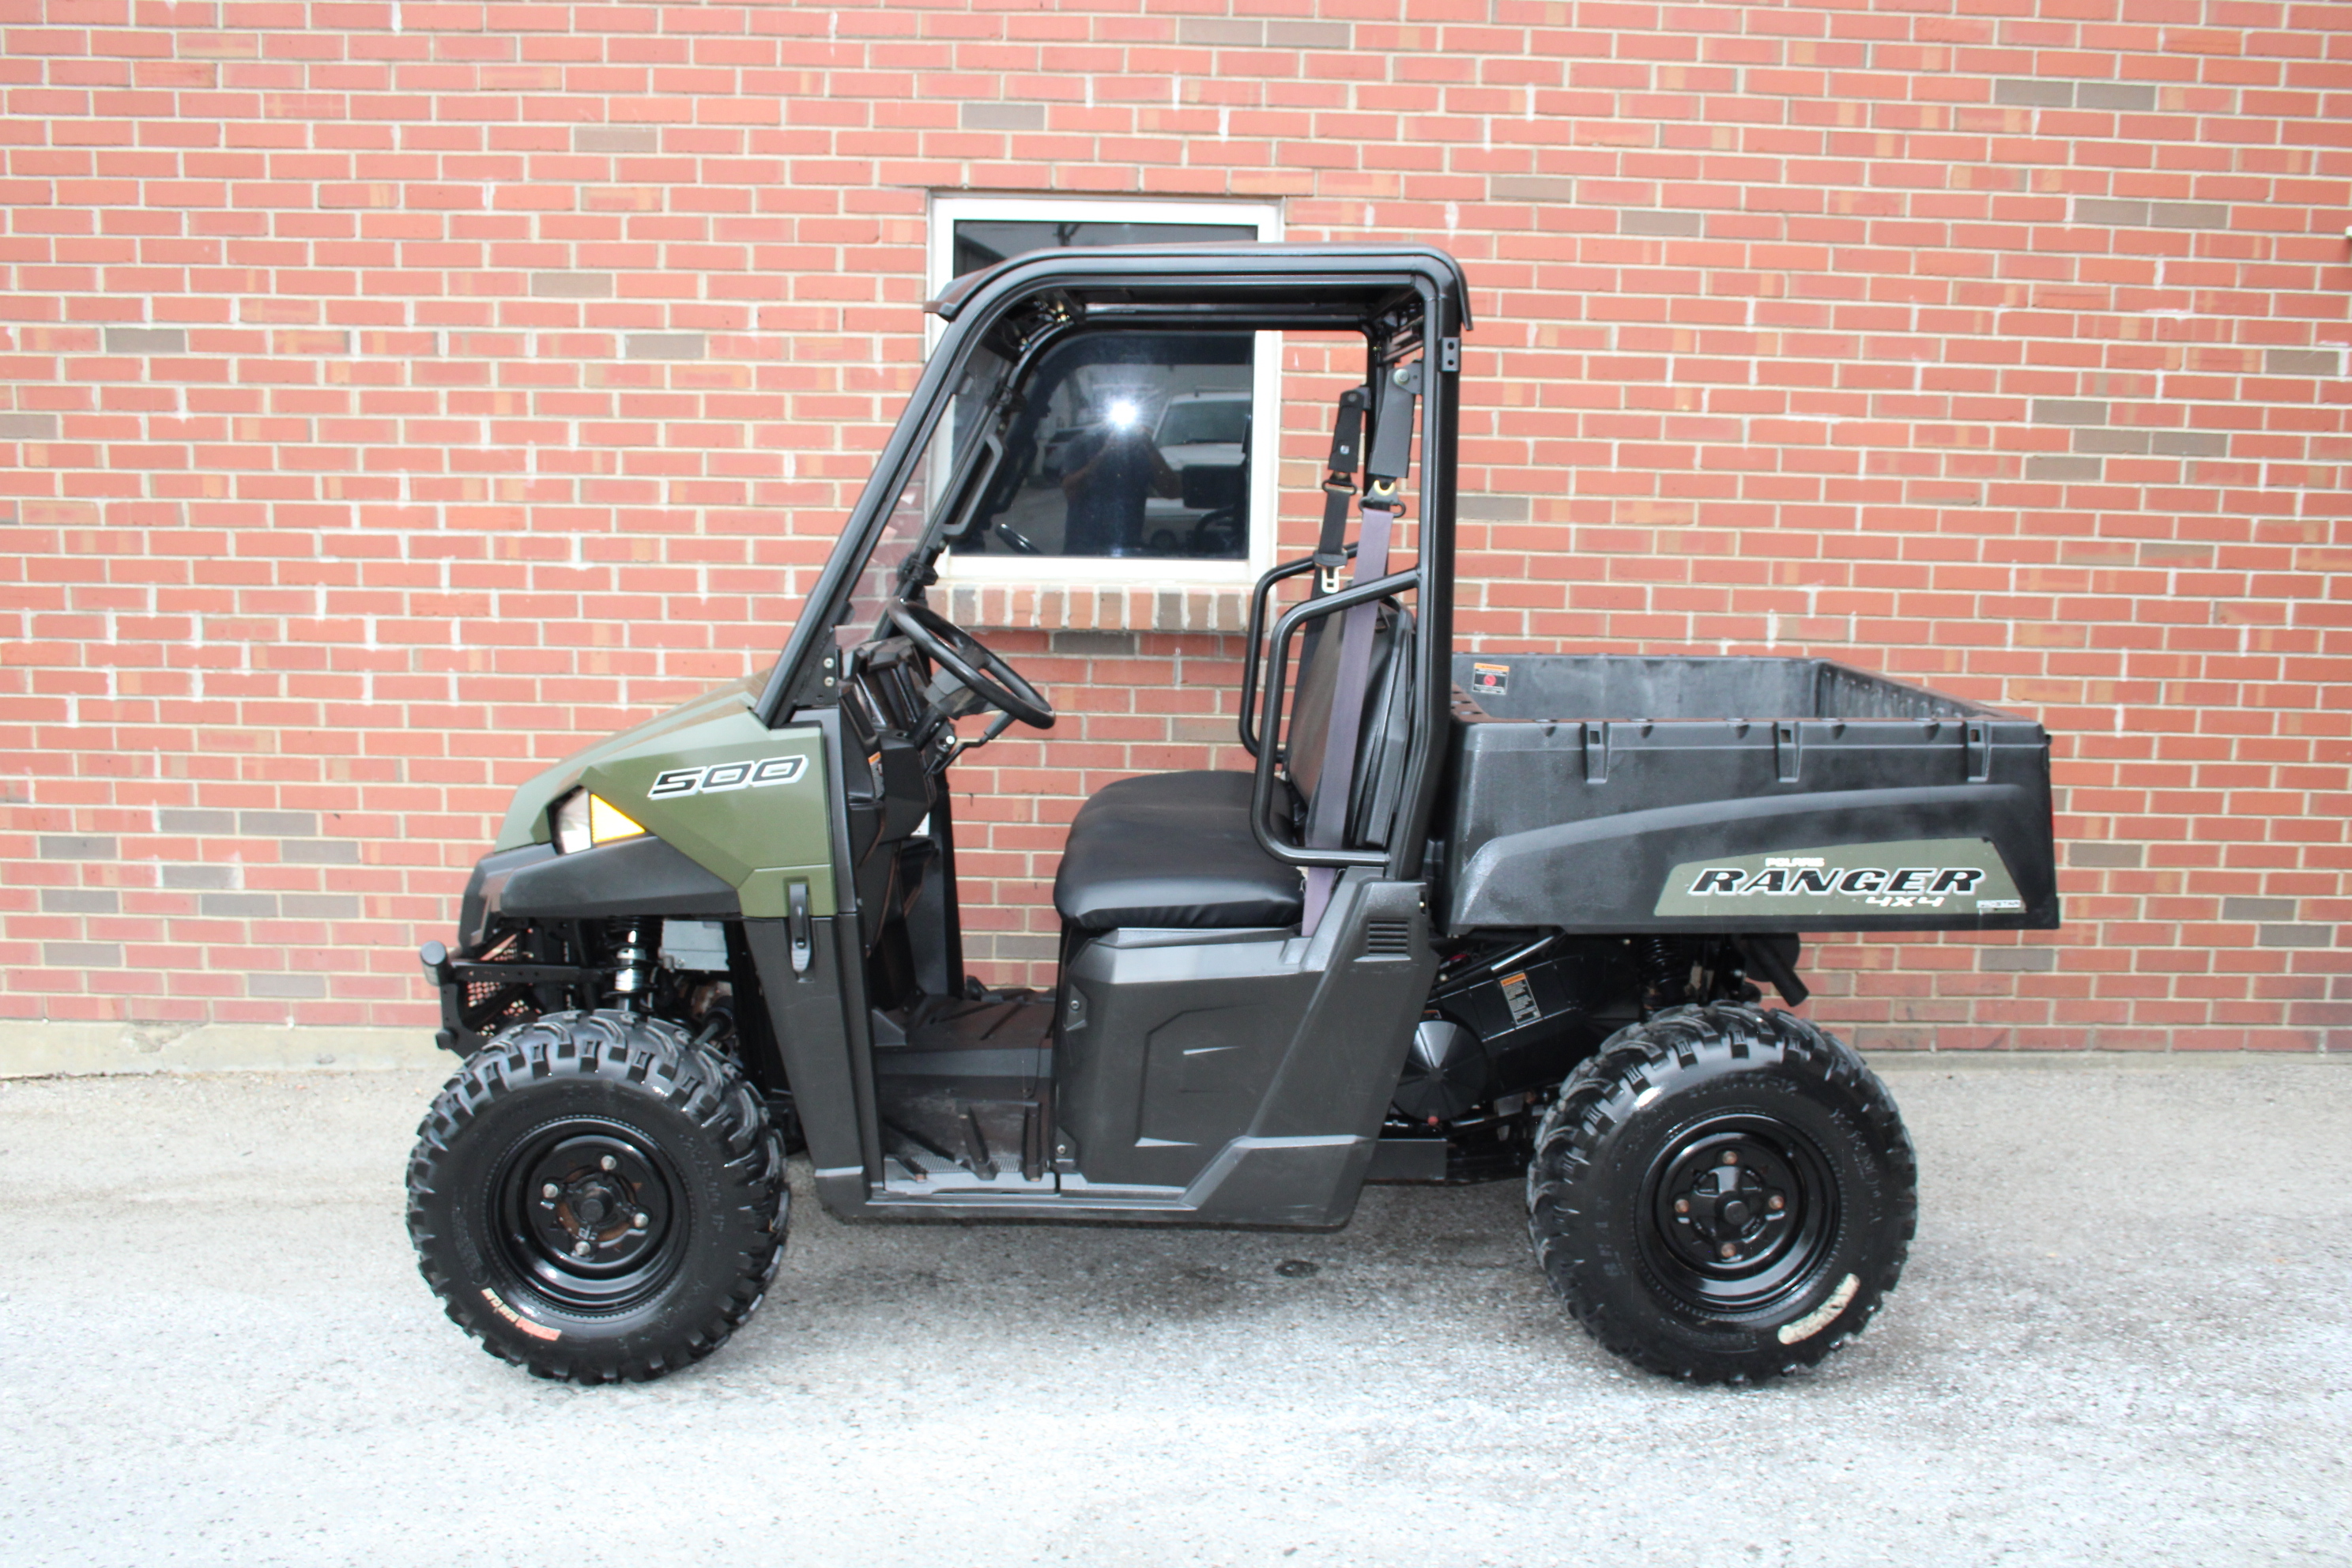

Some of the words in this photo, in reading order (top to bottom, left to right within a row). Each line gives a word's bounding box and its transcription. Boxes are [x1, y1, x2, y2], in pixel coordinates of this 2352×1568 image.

[647, 755, 808, 800] 500
[1765, 858, 1825, 867] POLARIS
[1687, 868, 1986, 895] RANGER
